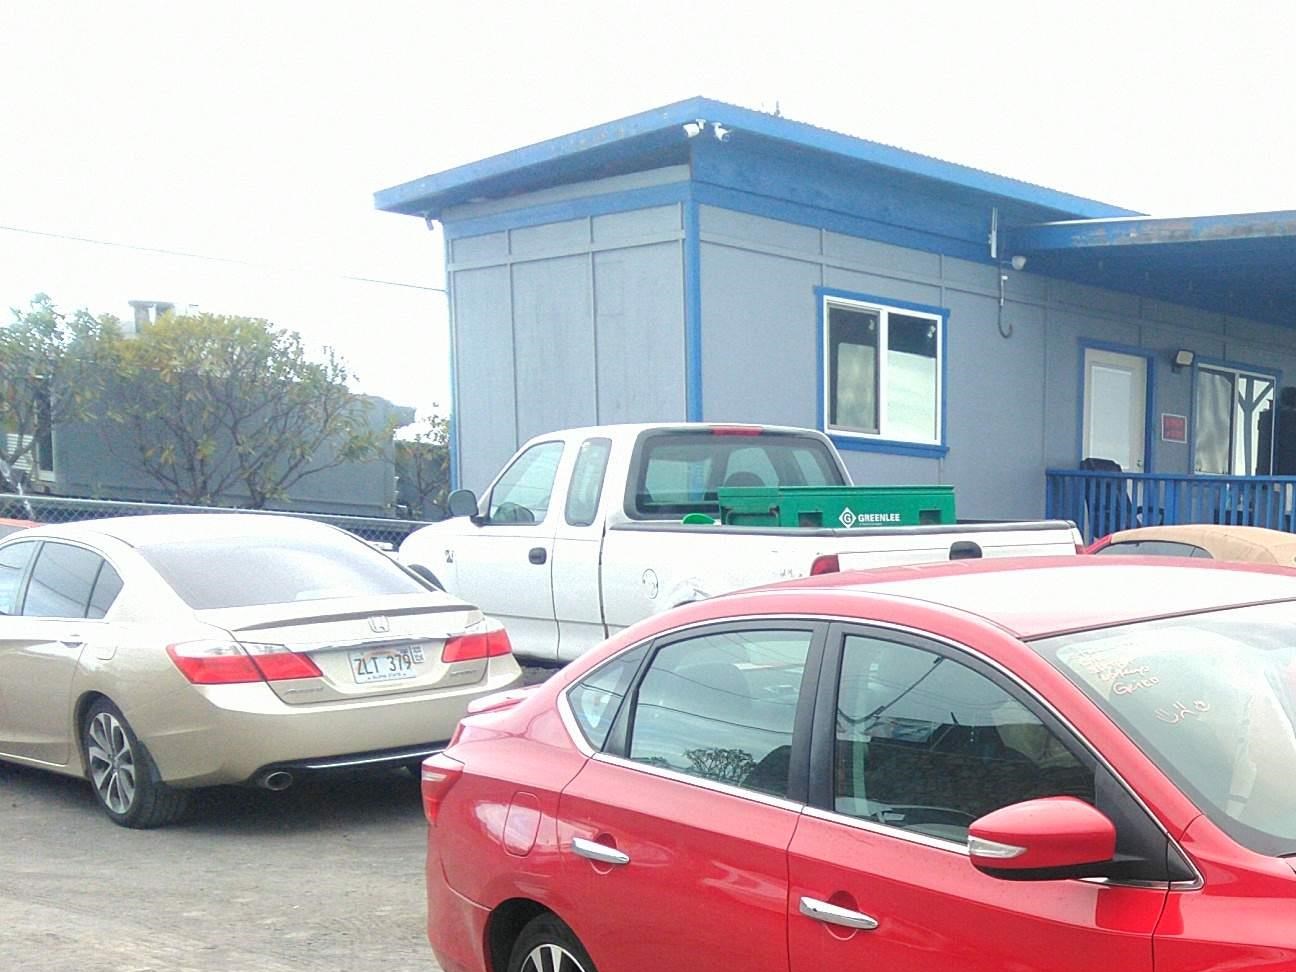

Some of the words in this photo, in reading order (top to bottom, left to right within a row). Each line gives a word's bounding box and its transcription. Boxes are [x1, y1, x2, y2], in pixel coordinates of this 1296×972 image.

[858, 513, 901, 522] GREENLEE
[353, 656, 379, 675] ZLT
[387, 654, 411, 671] 379
